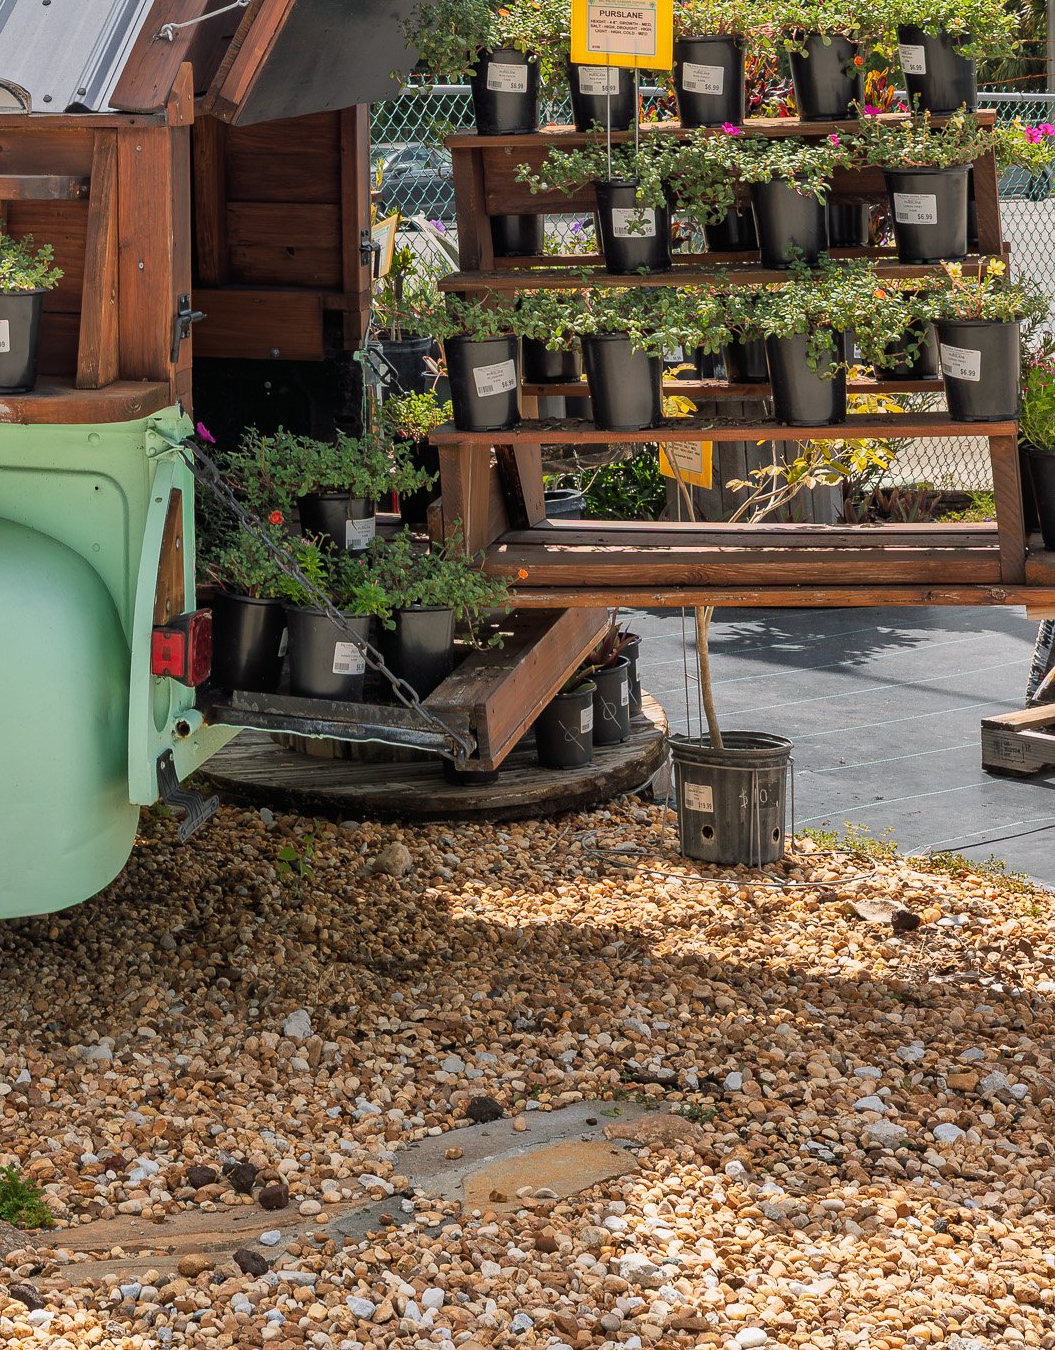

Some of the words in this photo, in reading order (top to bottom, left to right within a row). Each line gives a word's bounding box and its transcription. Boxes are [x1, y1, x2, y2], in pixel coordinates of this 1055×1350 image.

[599, 10, 643, 19] PURSLANE
[704, 83, 720, 91] $6.99
[960, 368, 976, 377] $6.99
